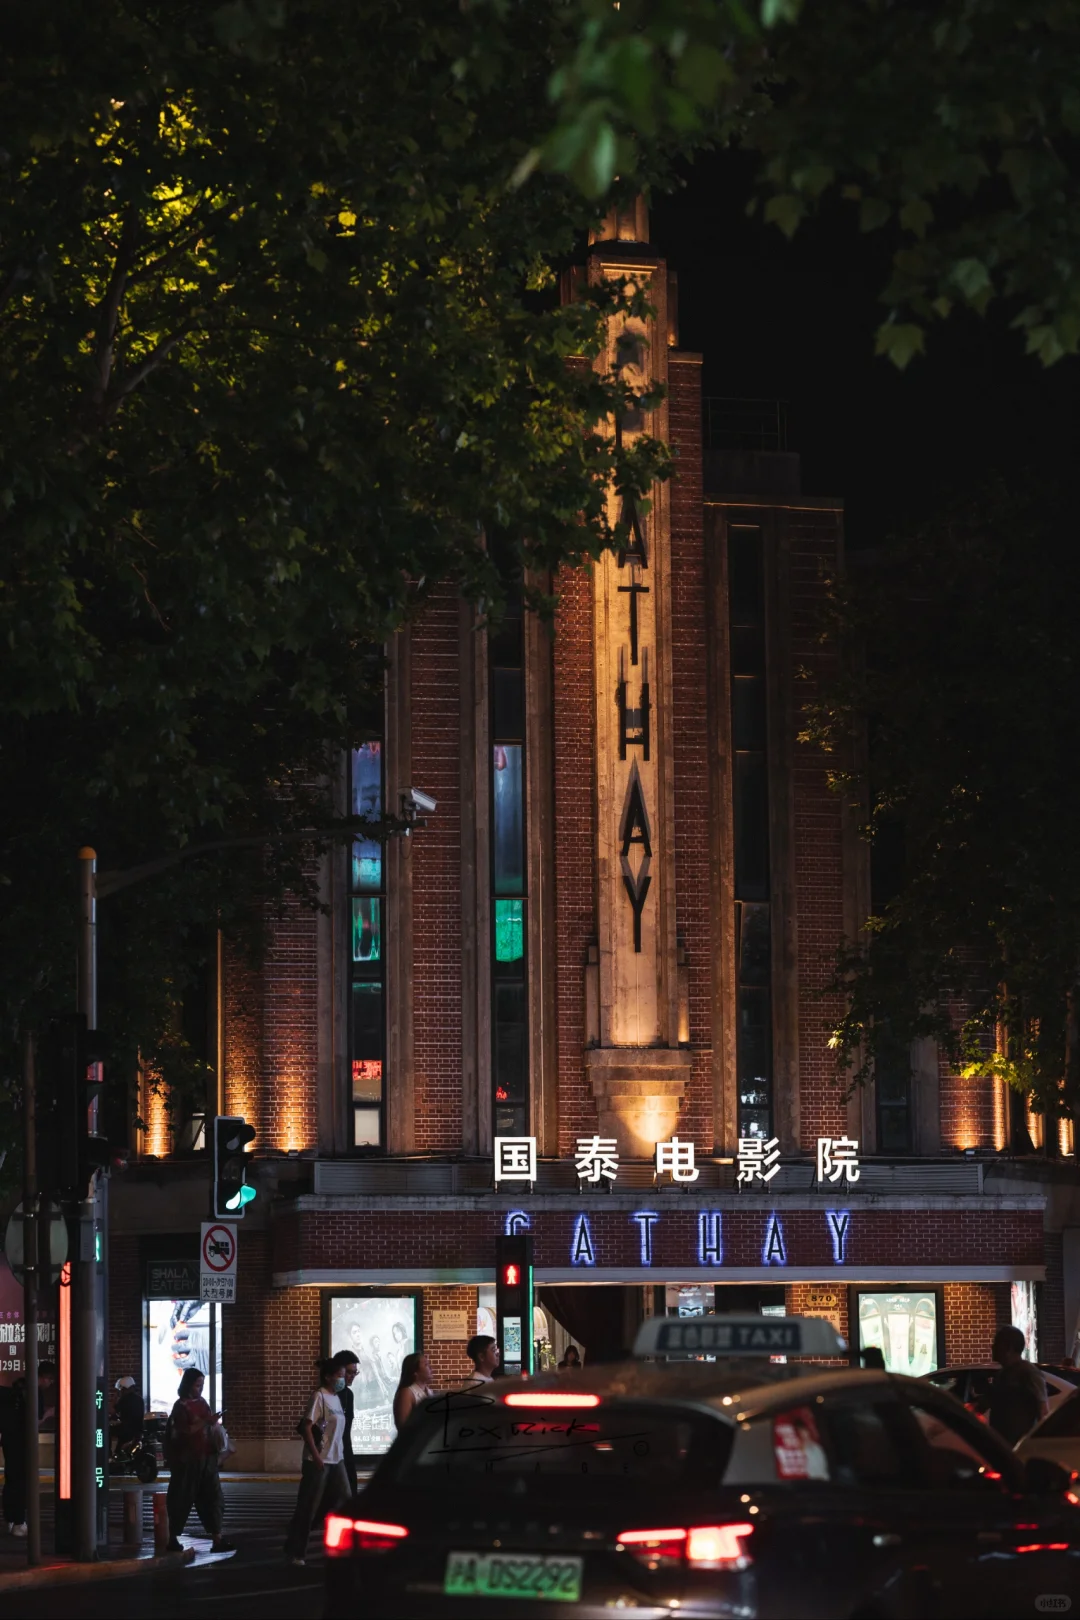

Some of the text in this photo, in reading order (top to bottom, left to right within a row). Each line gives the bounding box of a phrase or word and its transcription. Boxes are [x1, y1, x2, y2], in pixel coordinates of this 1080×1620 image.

[616, 395, 651, 953] ATHAY
[494, 1135, 861, 1183] 国泰电影院
[151, 1267, 189, 1279] SHALA
[151, 1279, 196, 1291] EATERY
[203, 1288, 233, 1299] 大型号牌
[738, 1327, 793, 1347] TAXI
